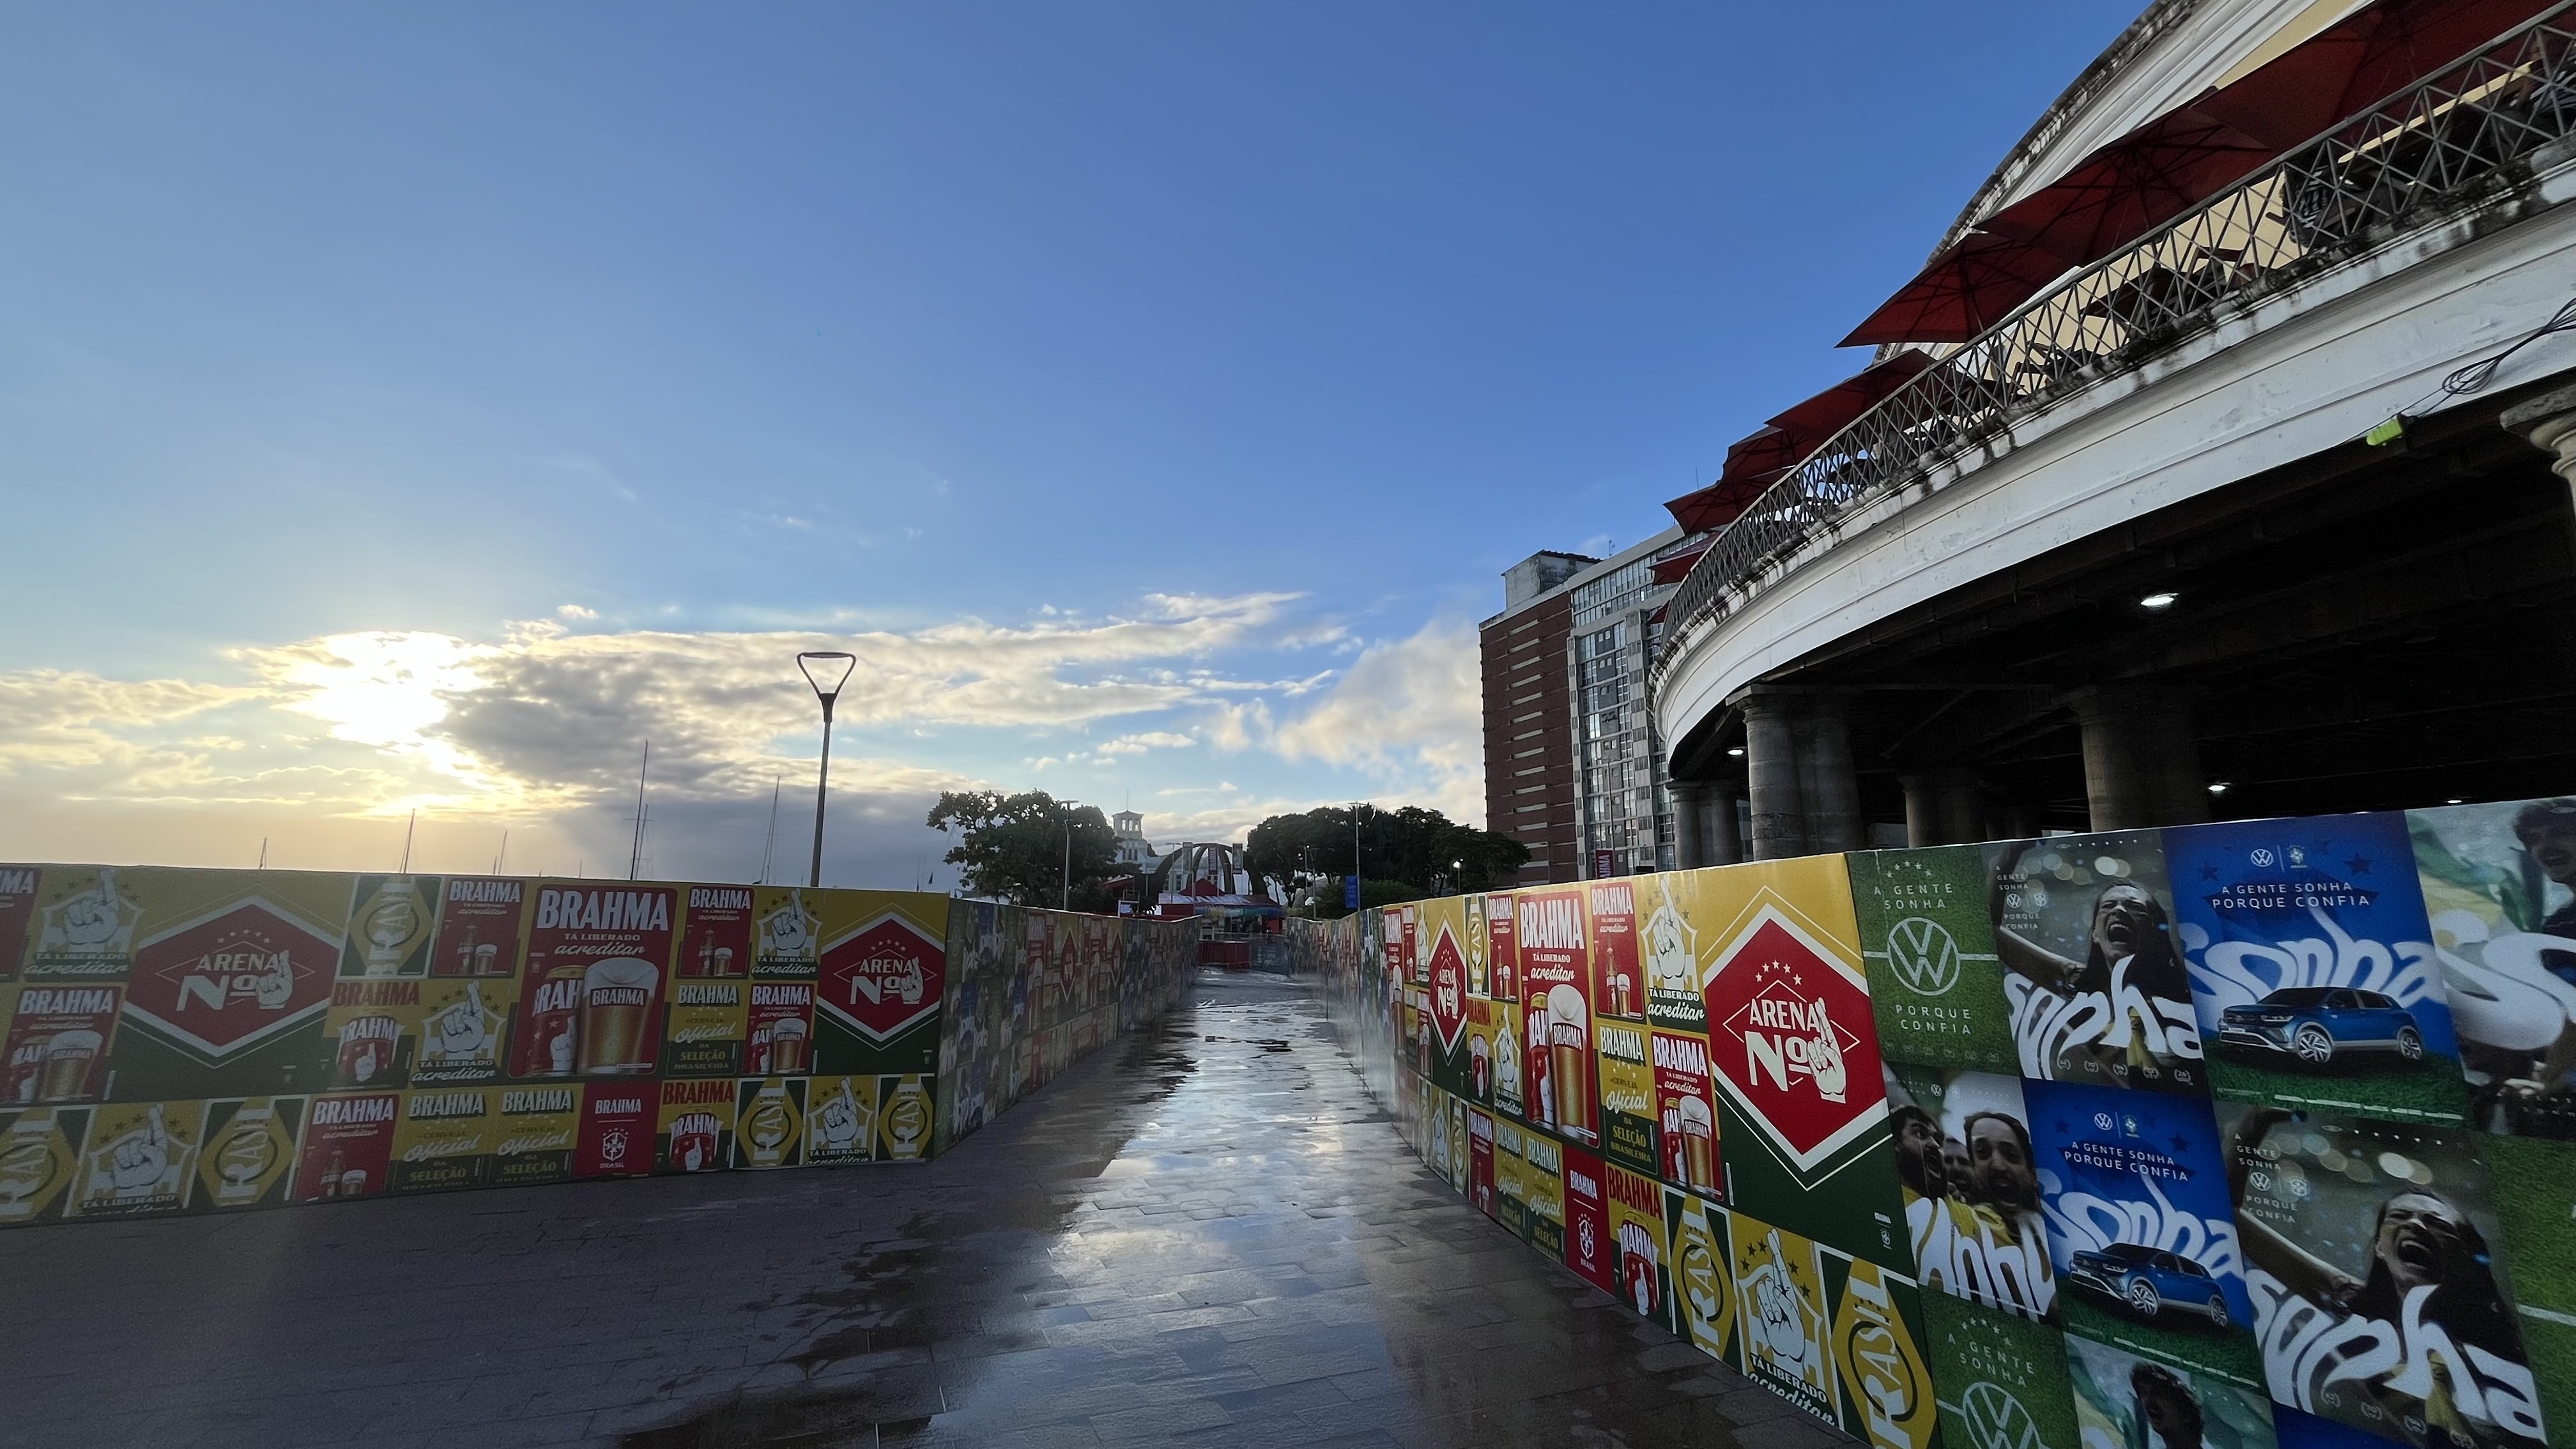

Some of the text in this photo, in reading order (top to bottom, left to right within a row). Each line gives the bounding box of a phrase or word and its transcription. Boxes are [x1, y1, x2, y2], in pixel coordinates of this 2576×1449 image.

[448, 880, 521, 903] BRAHMA
[1873, 883, 1953, 895] A GENTE
[2221, 882, 2354, 894] A GENTE SONHA
[689, 889, 751, 909] BRAHMA
[1591, 886, 1634, 916] BRAHMA
[1884, 898, 1947, 910] SONHA
[2212, 894, 2370, 910] PORQUE CONFIA
[537, 889, 669, 931] BRAHMA
[1519, 898, 1584, 949] BRAHMA
[564, 932, 641, 942] TÁ LIBERADO
[554, 941, 646, 956] acreditar
[1532, 952, 1571, 963] TÁ LIBERADO
[24, 961, 130, 974] acreditar
[195, 953, 279, 971] ARENA
[751, 963, 818, 975] acreditar
[858, 958, 913, 974] ARENA
[1530, 963, 1575, 982] acreditar
[17, 990, 114, 1015] BRAHMA
[332, 981, 420, 1008] BRAHMA
[592, 989, 644, 1006] BRAHMA
[677, 985, 737, 1004] BRAHMA
[751, 985, 811, 1006] BRAHMA
[1648, 987, 1699, 1002] TÁ LIBERADO
[1646, 1000, 1705, 1021] acreditar
[1749, 997, 1821, 1032] ARENA
[1895, 1004, 1972, 1020] PORQUE
[675, 1022, 737, 1044] Oficial
[1900, 1018, 1972, 1035] CONFIA
[1553, 1024, 1583, 1050] BRAHMA
[1599, 1026, 1644, 1062] BRAHMA
[435, 1059, 493, 1068] LIBERADO
[680, 1048, 726, 1062] SELEÇÃO
[1652, 1035, 1708, 1077] BRAHMA
[411, 1067, 496, 1082] acreditar
[662, 1080, 735, 1105] BRAHMA
[1664, 1080, 1701, 1096] acreditar
[408, 1093, 484, 1118] BRAHMA
[501, 1089, 572, 1113] BRAHMA
[594, 1098, 642, 1115] BRAHMA
[1606, 1089, 1648, 1114] Oficial
[312, 1098, 394, 1125] BRAHMA
[1612, 1125, 1647, 1148] SELEÇÃO
[1685, 1120, 1709, 1140] BRAHMA
[403, 1134, 483, 1163] Oficial
[497, 1129, 571, 1156] Oficial
[822, 1147, 867, 1156] LIBERADO
[1610, 1140, 1652, 1163] BRASILEIRA
[2236, 1145, 2276, 1158] GENTE
[1526, 1136, 1560, 1174] BRAHMA
[2071, 1140, 2175, 1166] A GENTE SONHA
[410, 1166, 468, 1182] SELEÇÃO
[503, 1160, 558, 1175] SELEÇÃO
[2064, 1151, 2189, 1182] PORQUE CONFIA
[2238, 1157, 2281, 1171] SONHA
[1569, 1169, 1598, 1200] BRAHMA
[1606, 1165, 1664, 1221] BRAHMA
[2245, 1195, 2299, 1211] PORQUE
[2248, 1208, 2296, 1224] CONFIA
[1580, 1257, 1596, 1273] BRASIL
[1947, 1332, 2036, 1375] A GENTE
[1750, 1353, 1828, 1404] TÁ LIBERADO
[1958, 1351, 2028, 1388] SONHA
